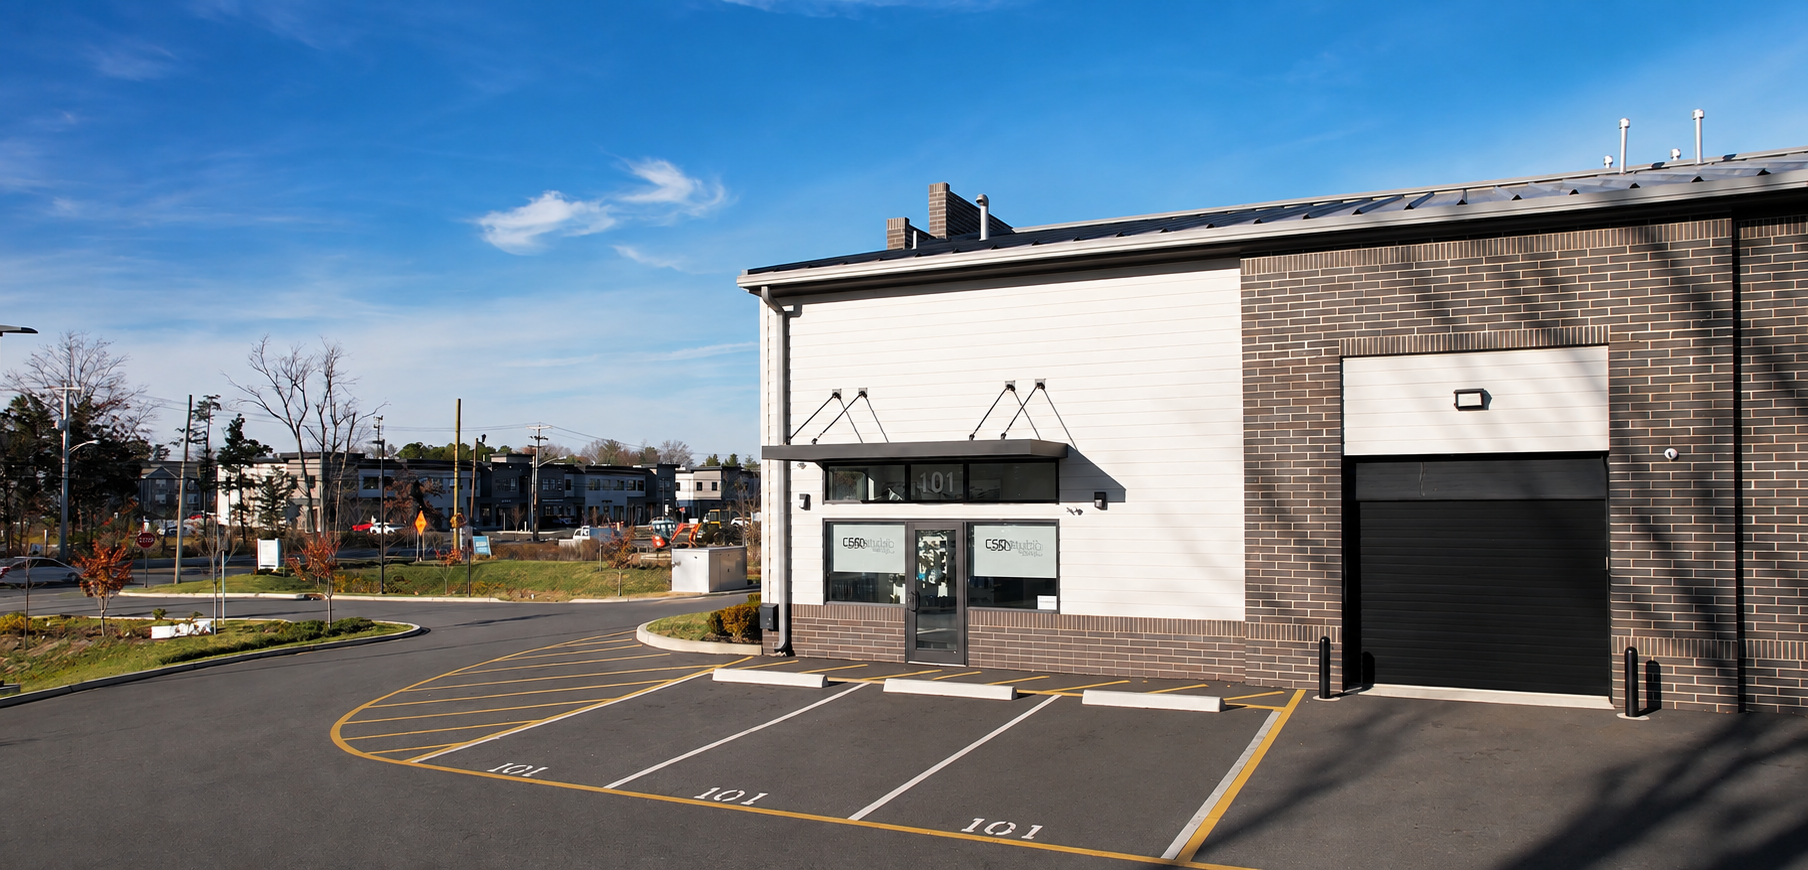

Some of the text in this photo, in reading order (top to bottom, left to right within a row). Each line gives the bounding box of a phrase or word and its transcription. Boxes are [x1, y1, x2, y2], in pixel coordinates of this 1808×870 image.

[920, 471, 954, 493] 101
[487, 763, 548, 777] 101
[694, 787, 768, 805] 101
[961, 817, 1043, 839] 101
